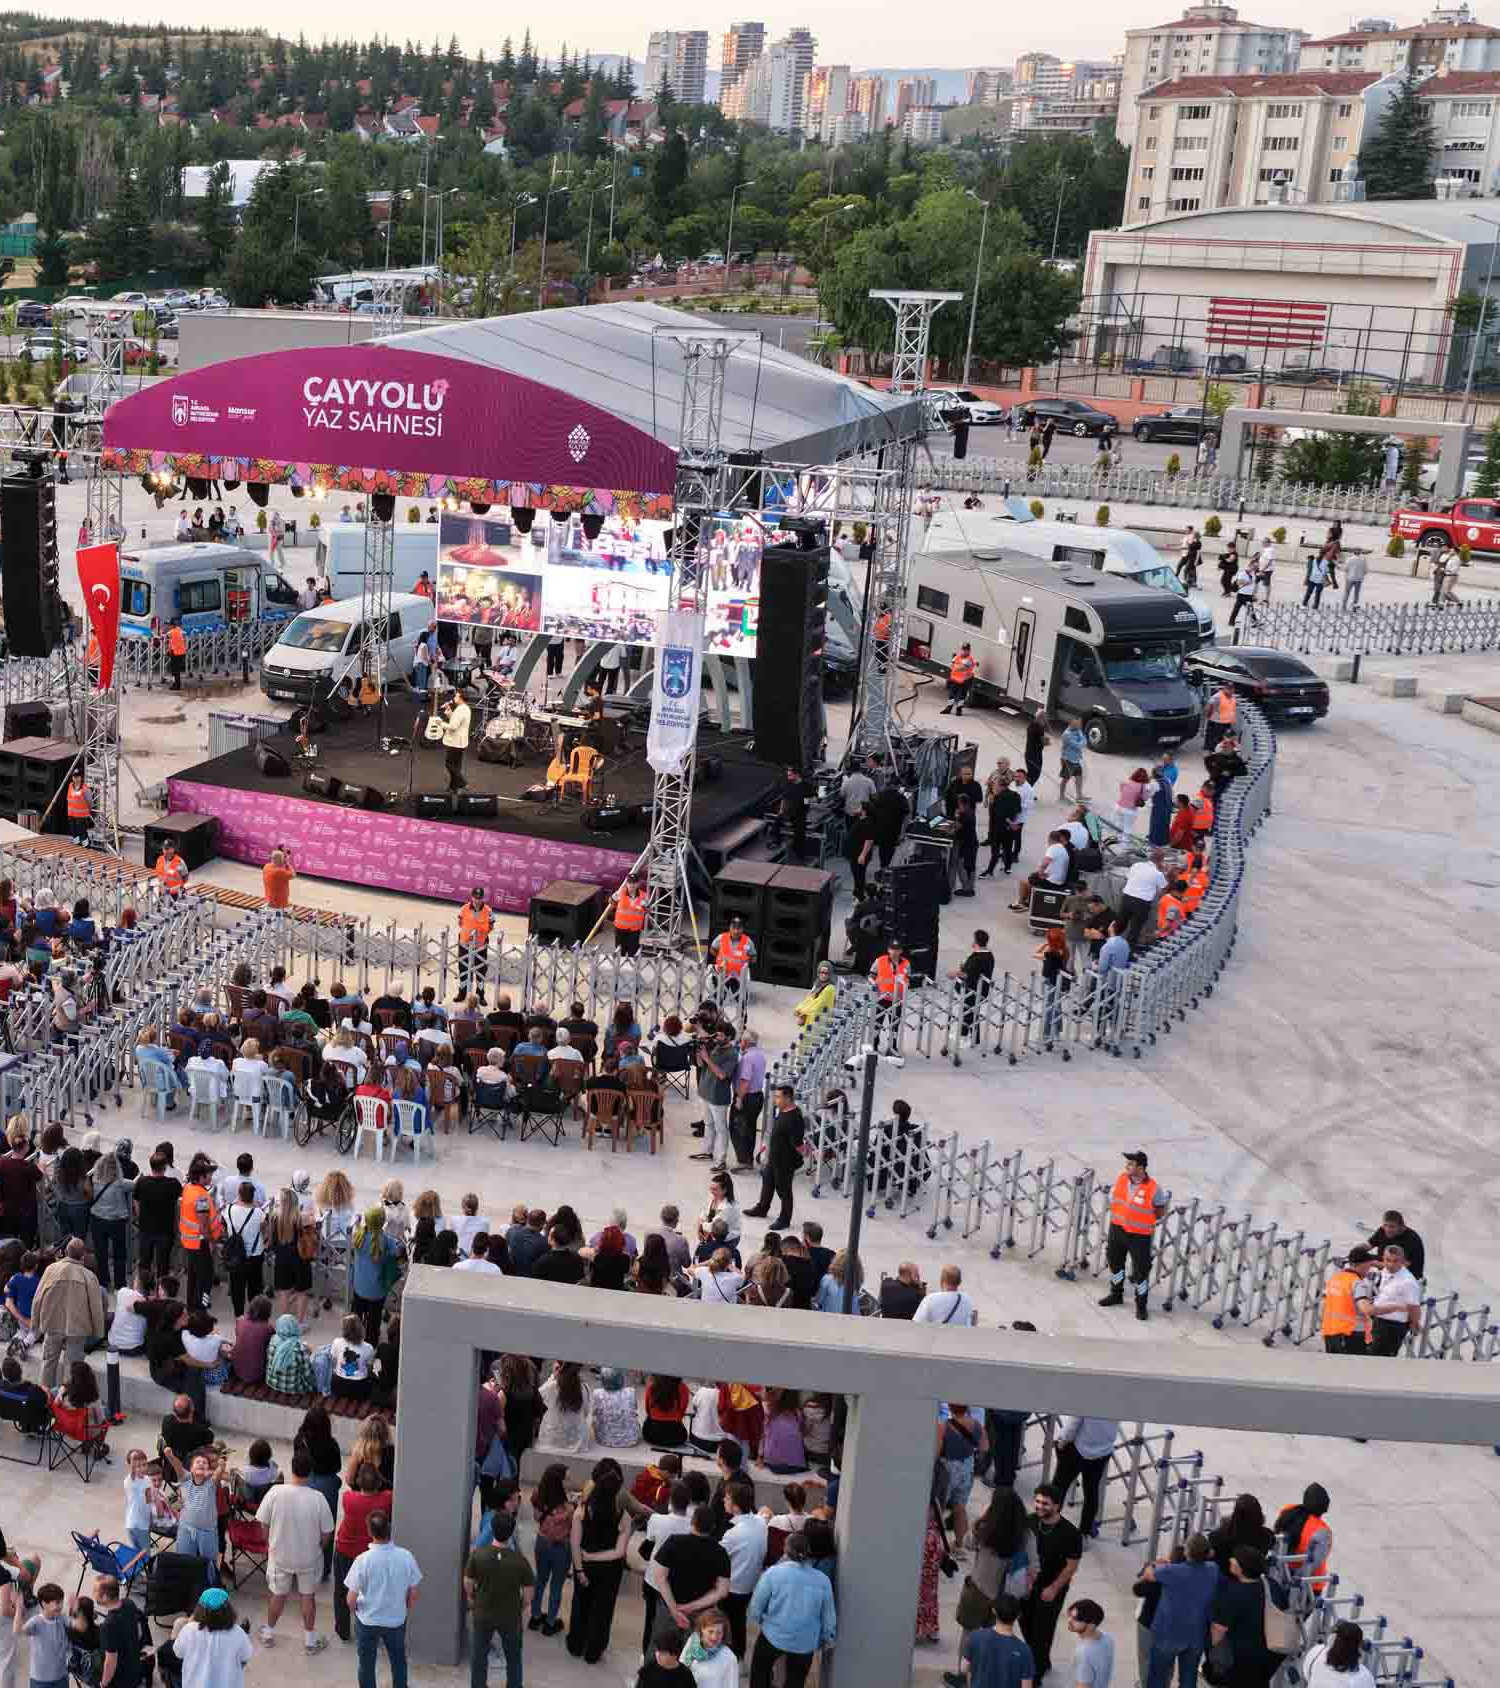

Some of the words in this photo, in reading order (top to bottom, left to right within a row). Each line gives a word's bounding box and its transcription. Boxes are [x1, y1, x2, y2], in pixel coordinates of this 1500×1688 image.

[303, 376, 444, 411] ÇAYYOLU
[303, 407, 343, 429] YAZ
[348, 411, 443, 437] SAHNESİ
